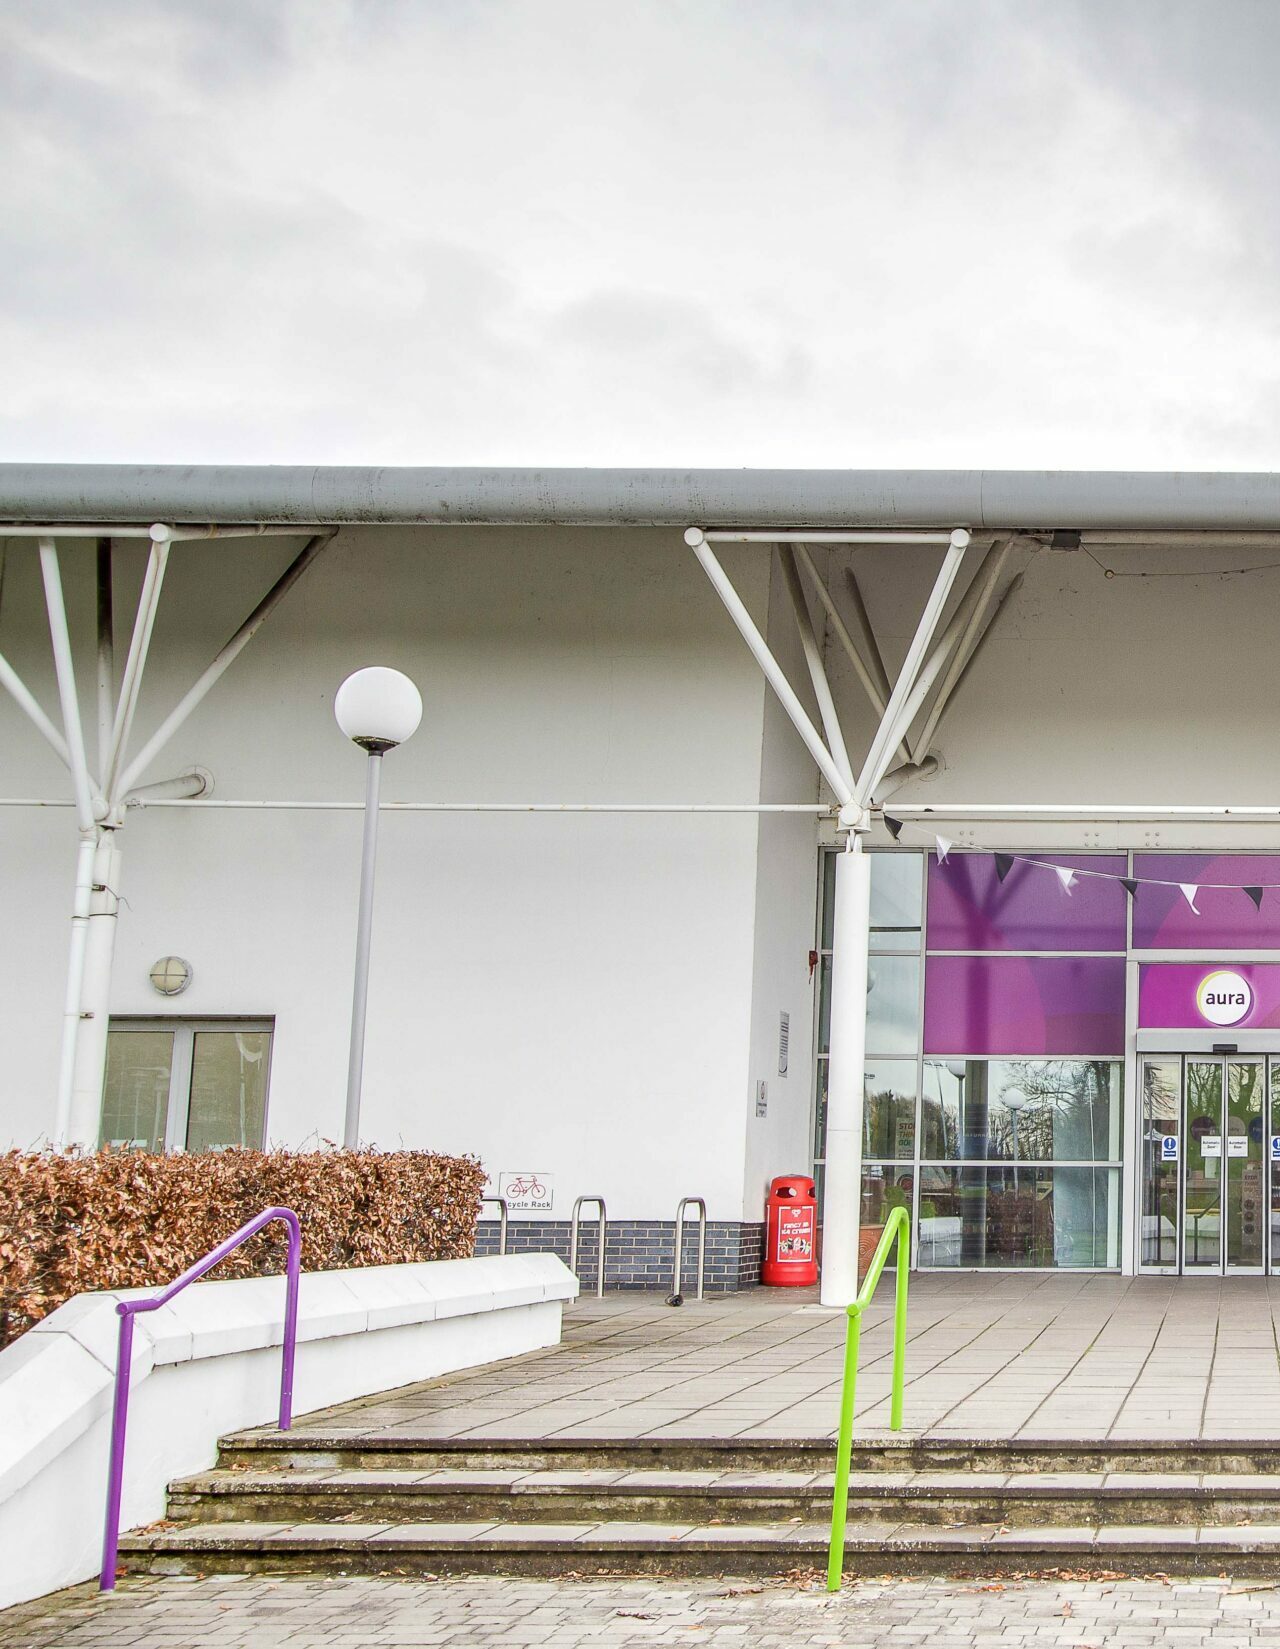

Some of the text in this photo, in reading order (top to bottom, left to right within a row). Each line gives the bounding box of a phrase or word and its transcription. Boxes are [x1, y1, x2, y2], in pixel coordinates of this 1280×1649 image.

[1206, 993, 1245, 1005] aura
[899, 1122, 914, 1130] STO
[507, 1201, 529, 1209] cycle
